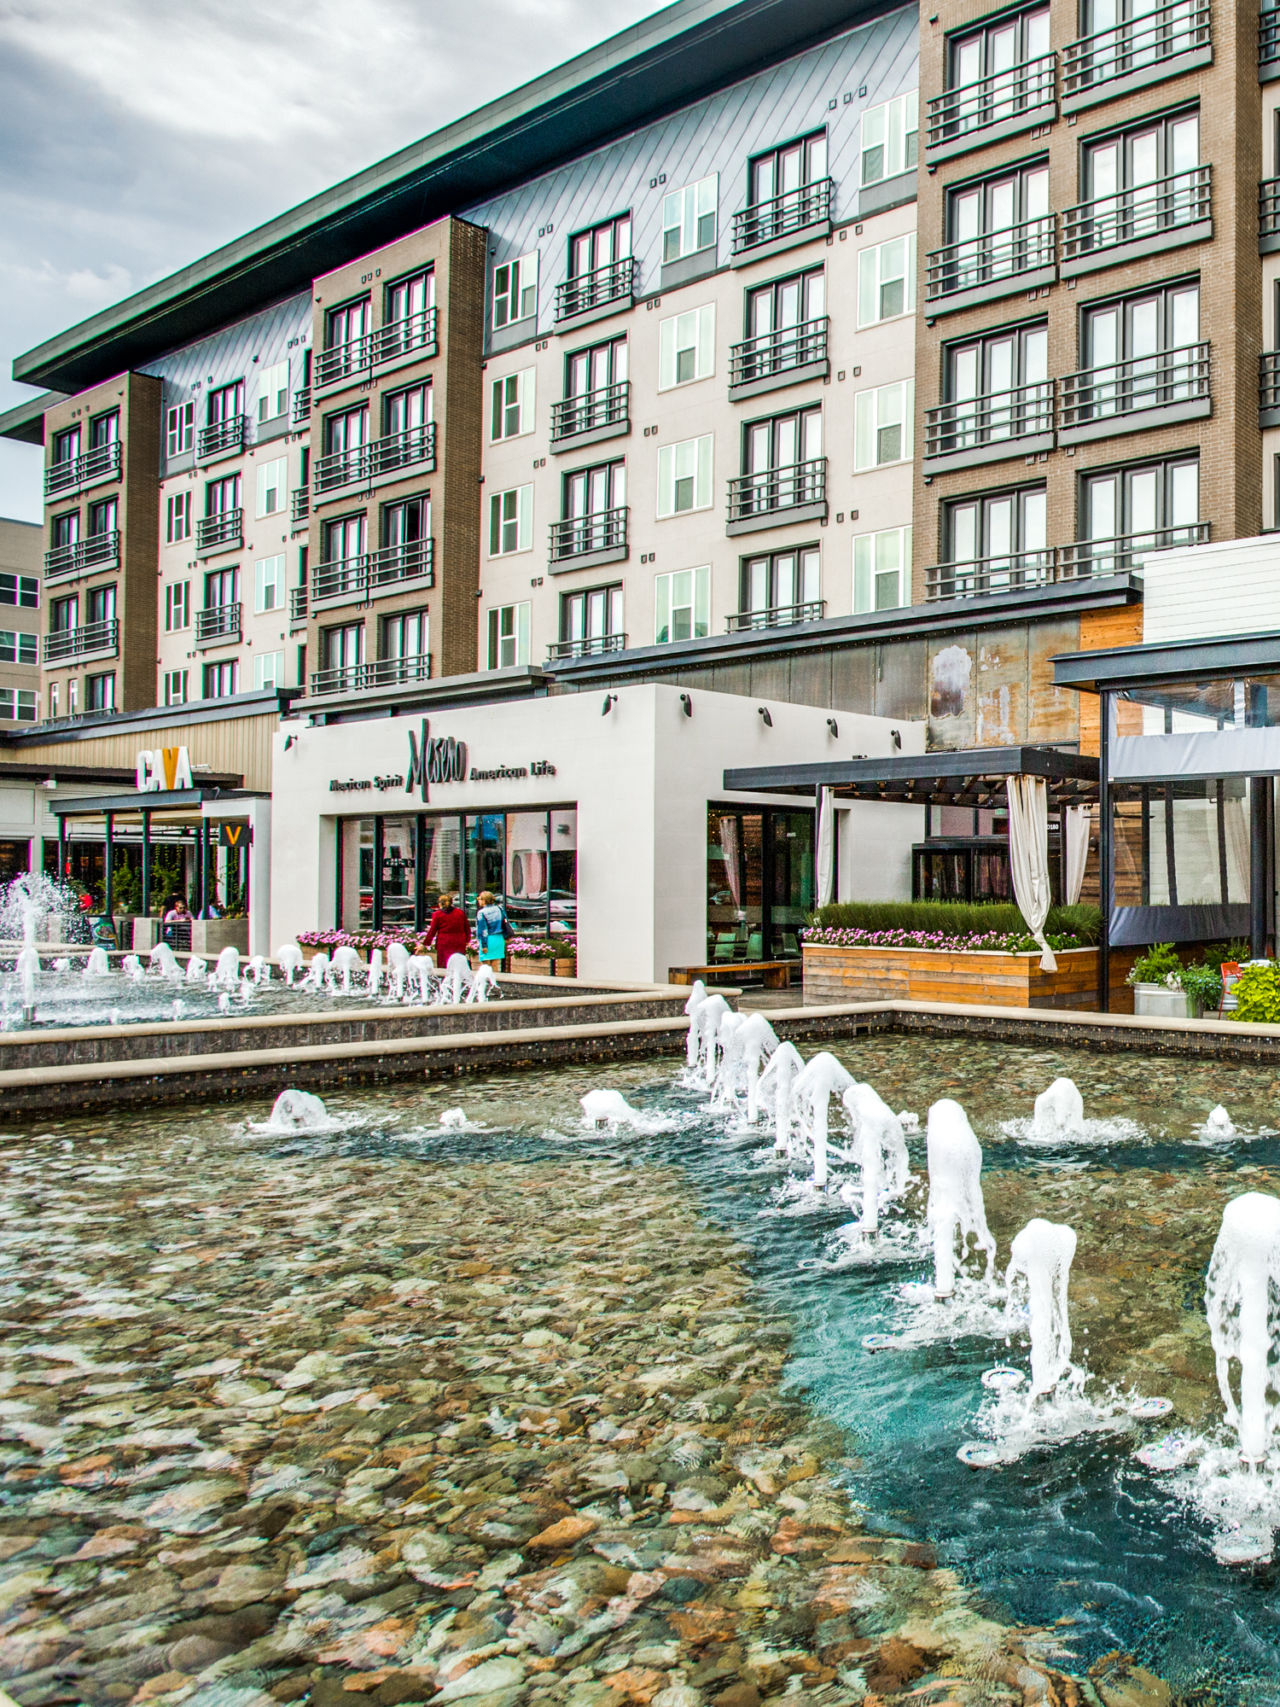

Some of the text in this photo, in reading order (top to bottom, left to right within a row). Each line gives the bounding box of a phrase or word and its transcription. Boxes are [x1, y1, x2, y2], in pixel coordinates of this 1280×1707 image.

[136, 745, 194, 792] CAVA
[405, 718, 467, 803] Mesero
[470, 760, 556, 781] American Life
[329, 774, 404, 792] Mexican Spirit
[225, 825, 243, 845] V
